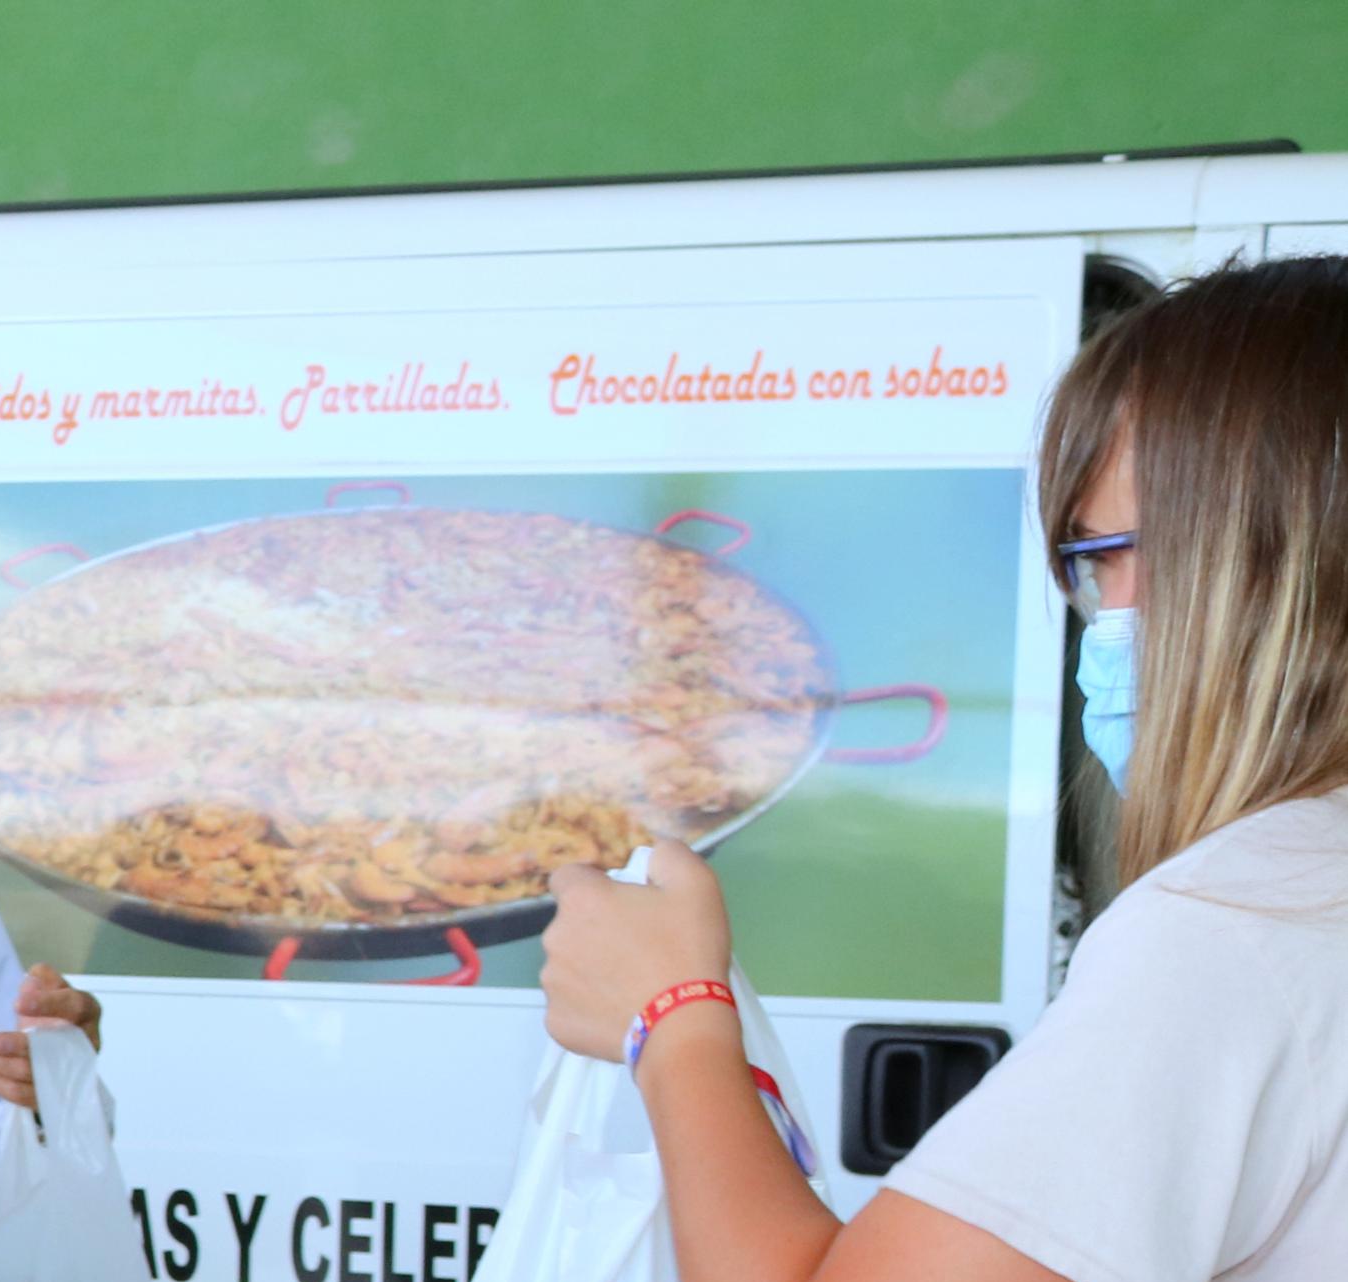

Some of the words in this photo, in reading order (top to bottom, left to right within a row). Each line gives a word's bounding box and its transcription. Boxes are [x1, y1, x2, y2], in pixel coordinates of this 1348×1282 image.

[52, 394, 80, 447] y
[88, 376, 267, 421] marmitas.
[278, 362, 512, 432] Parrilladas.
[548, 347, 800, 417] Chocolatadas
[805, 367, 875, 401] con
[881, 344, 1012, 400] sobaos
